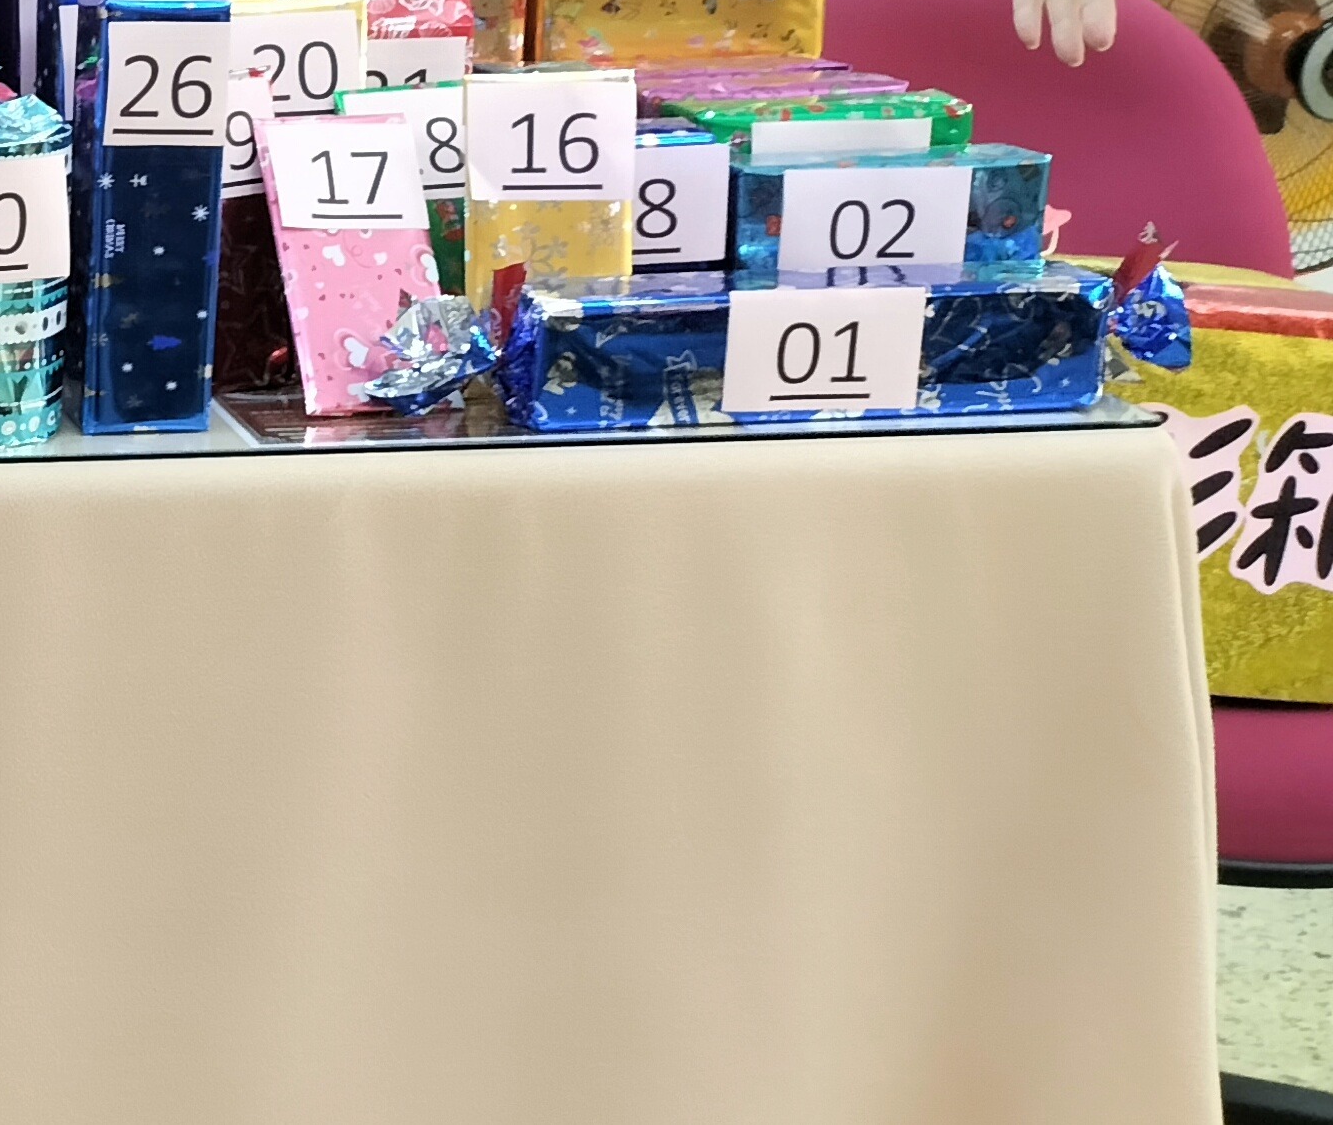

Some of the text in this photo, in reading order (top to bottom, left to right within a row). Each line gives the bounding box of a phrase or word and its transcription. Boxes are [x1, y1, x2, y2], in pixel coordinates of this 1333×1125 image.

[119, 54, 214, 119] 26
[253, 41, 339, 102] 20
[225, 109, 256, 171] 9
[420, 116, 466, 174] 8
[509, 111, 600, 175] 16
[311, 150, 389, 206] 17
[636, 177, 678, 239] 8
[829, 198, 916, 261] 02
[776, 320, 869, 386] 01
